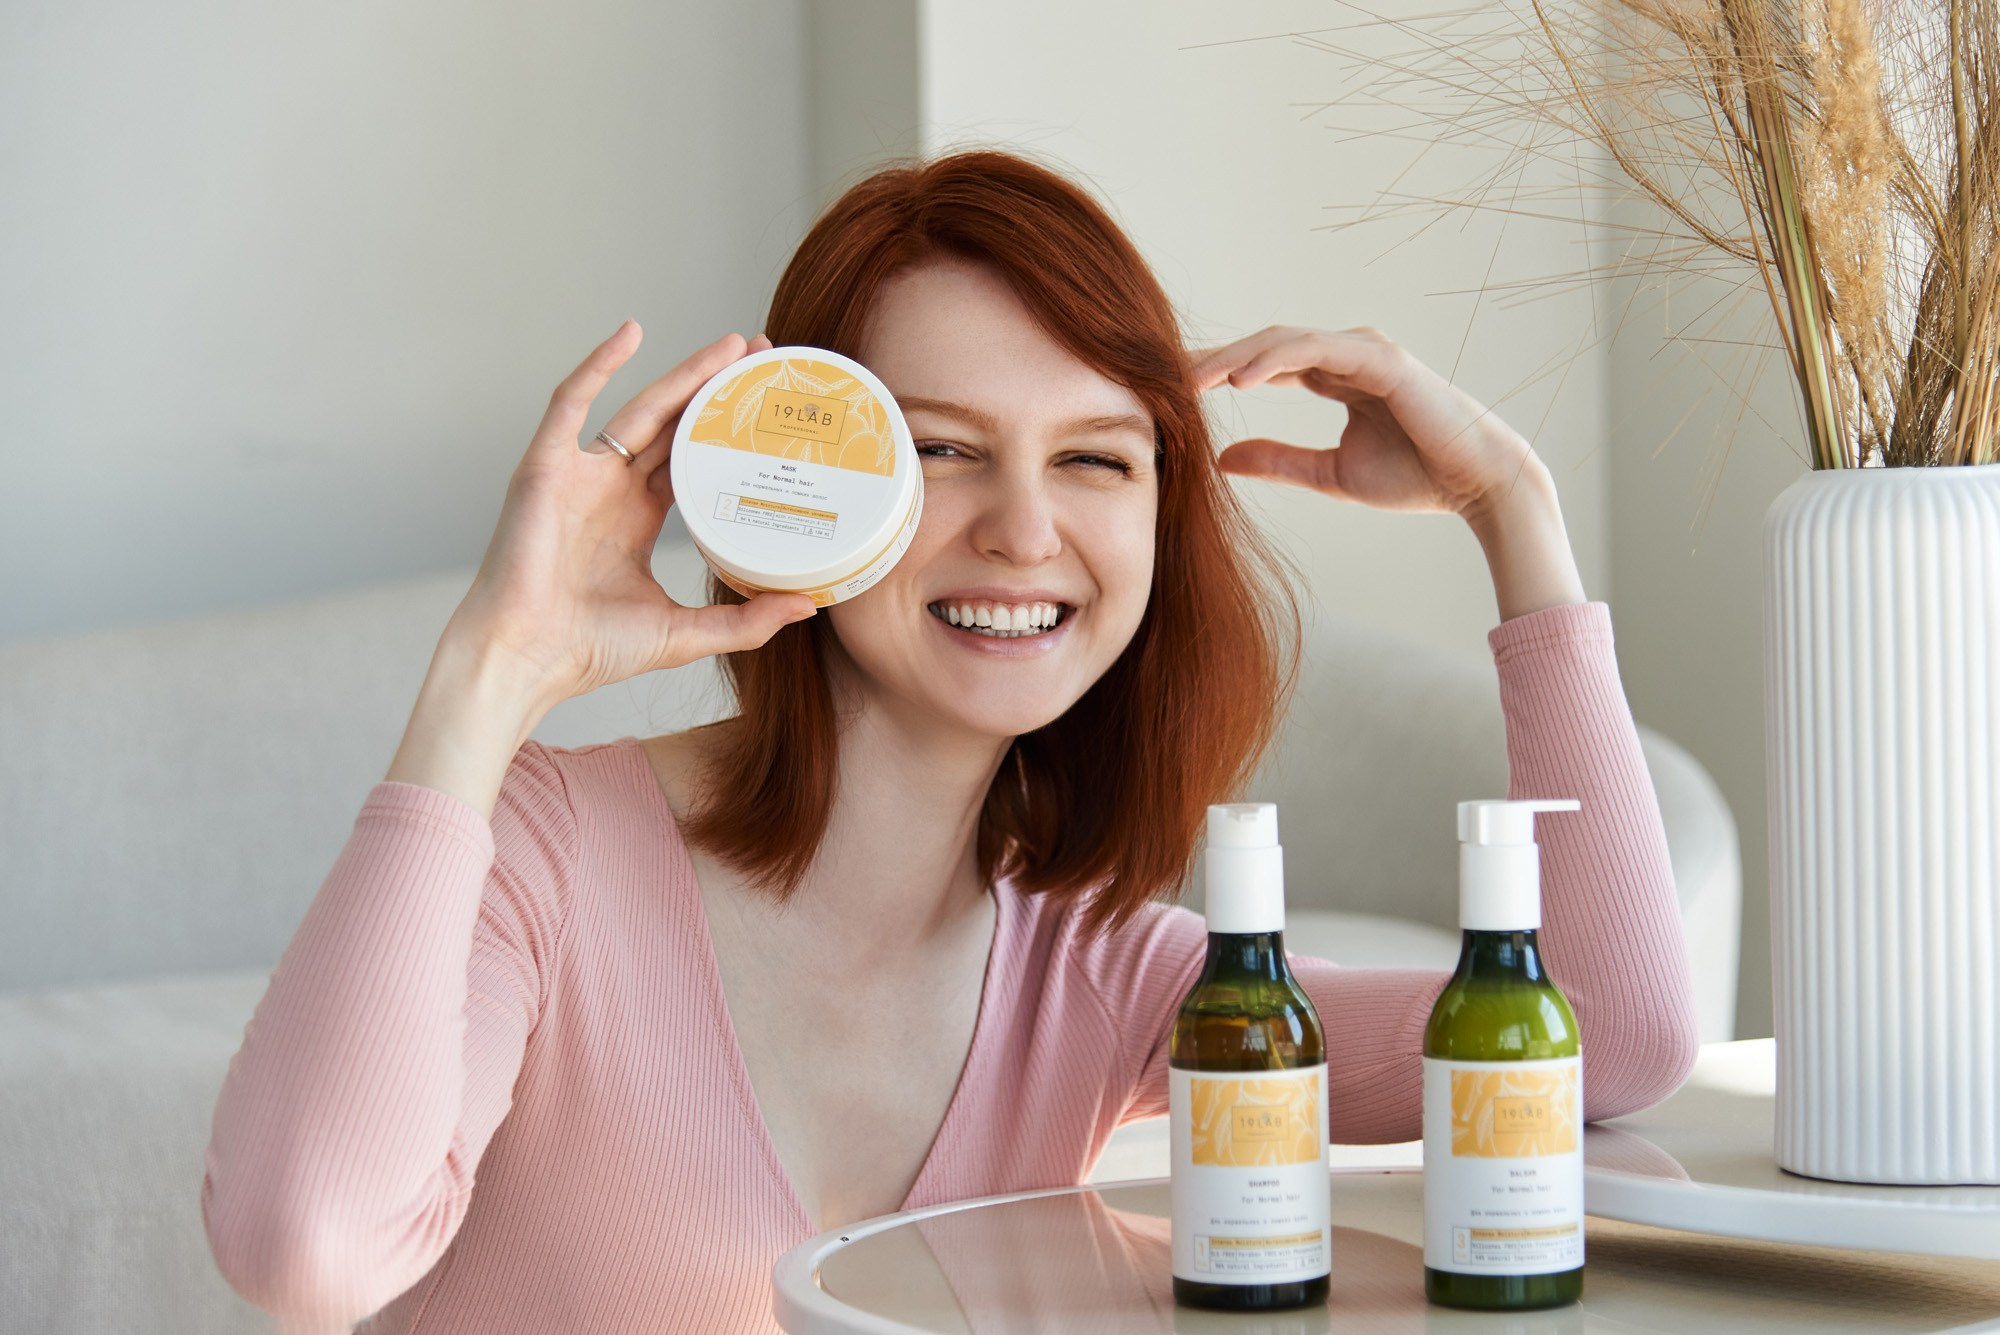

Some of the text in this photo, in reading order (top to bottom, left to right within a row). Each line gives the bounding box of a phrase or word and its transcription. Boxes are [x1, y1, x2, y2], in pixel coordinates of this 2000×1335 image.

[774, 404, 833, 426] 19LAB
[779, 424, 819, 435] PROFESSIONAL
[781, 464, 798, 473] MASK
[773, 475, 796, 484] Normal
[799, 479, 815, 487] hair
[1240, 1116, 1282, 1129] 19LAB
